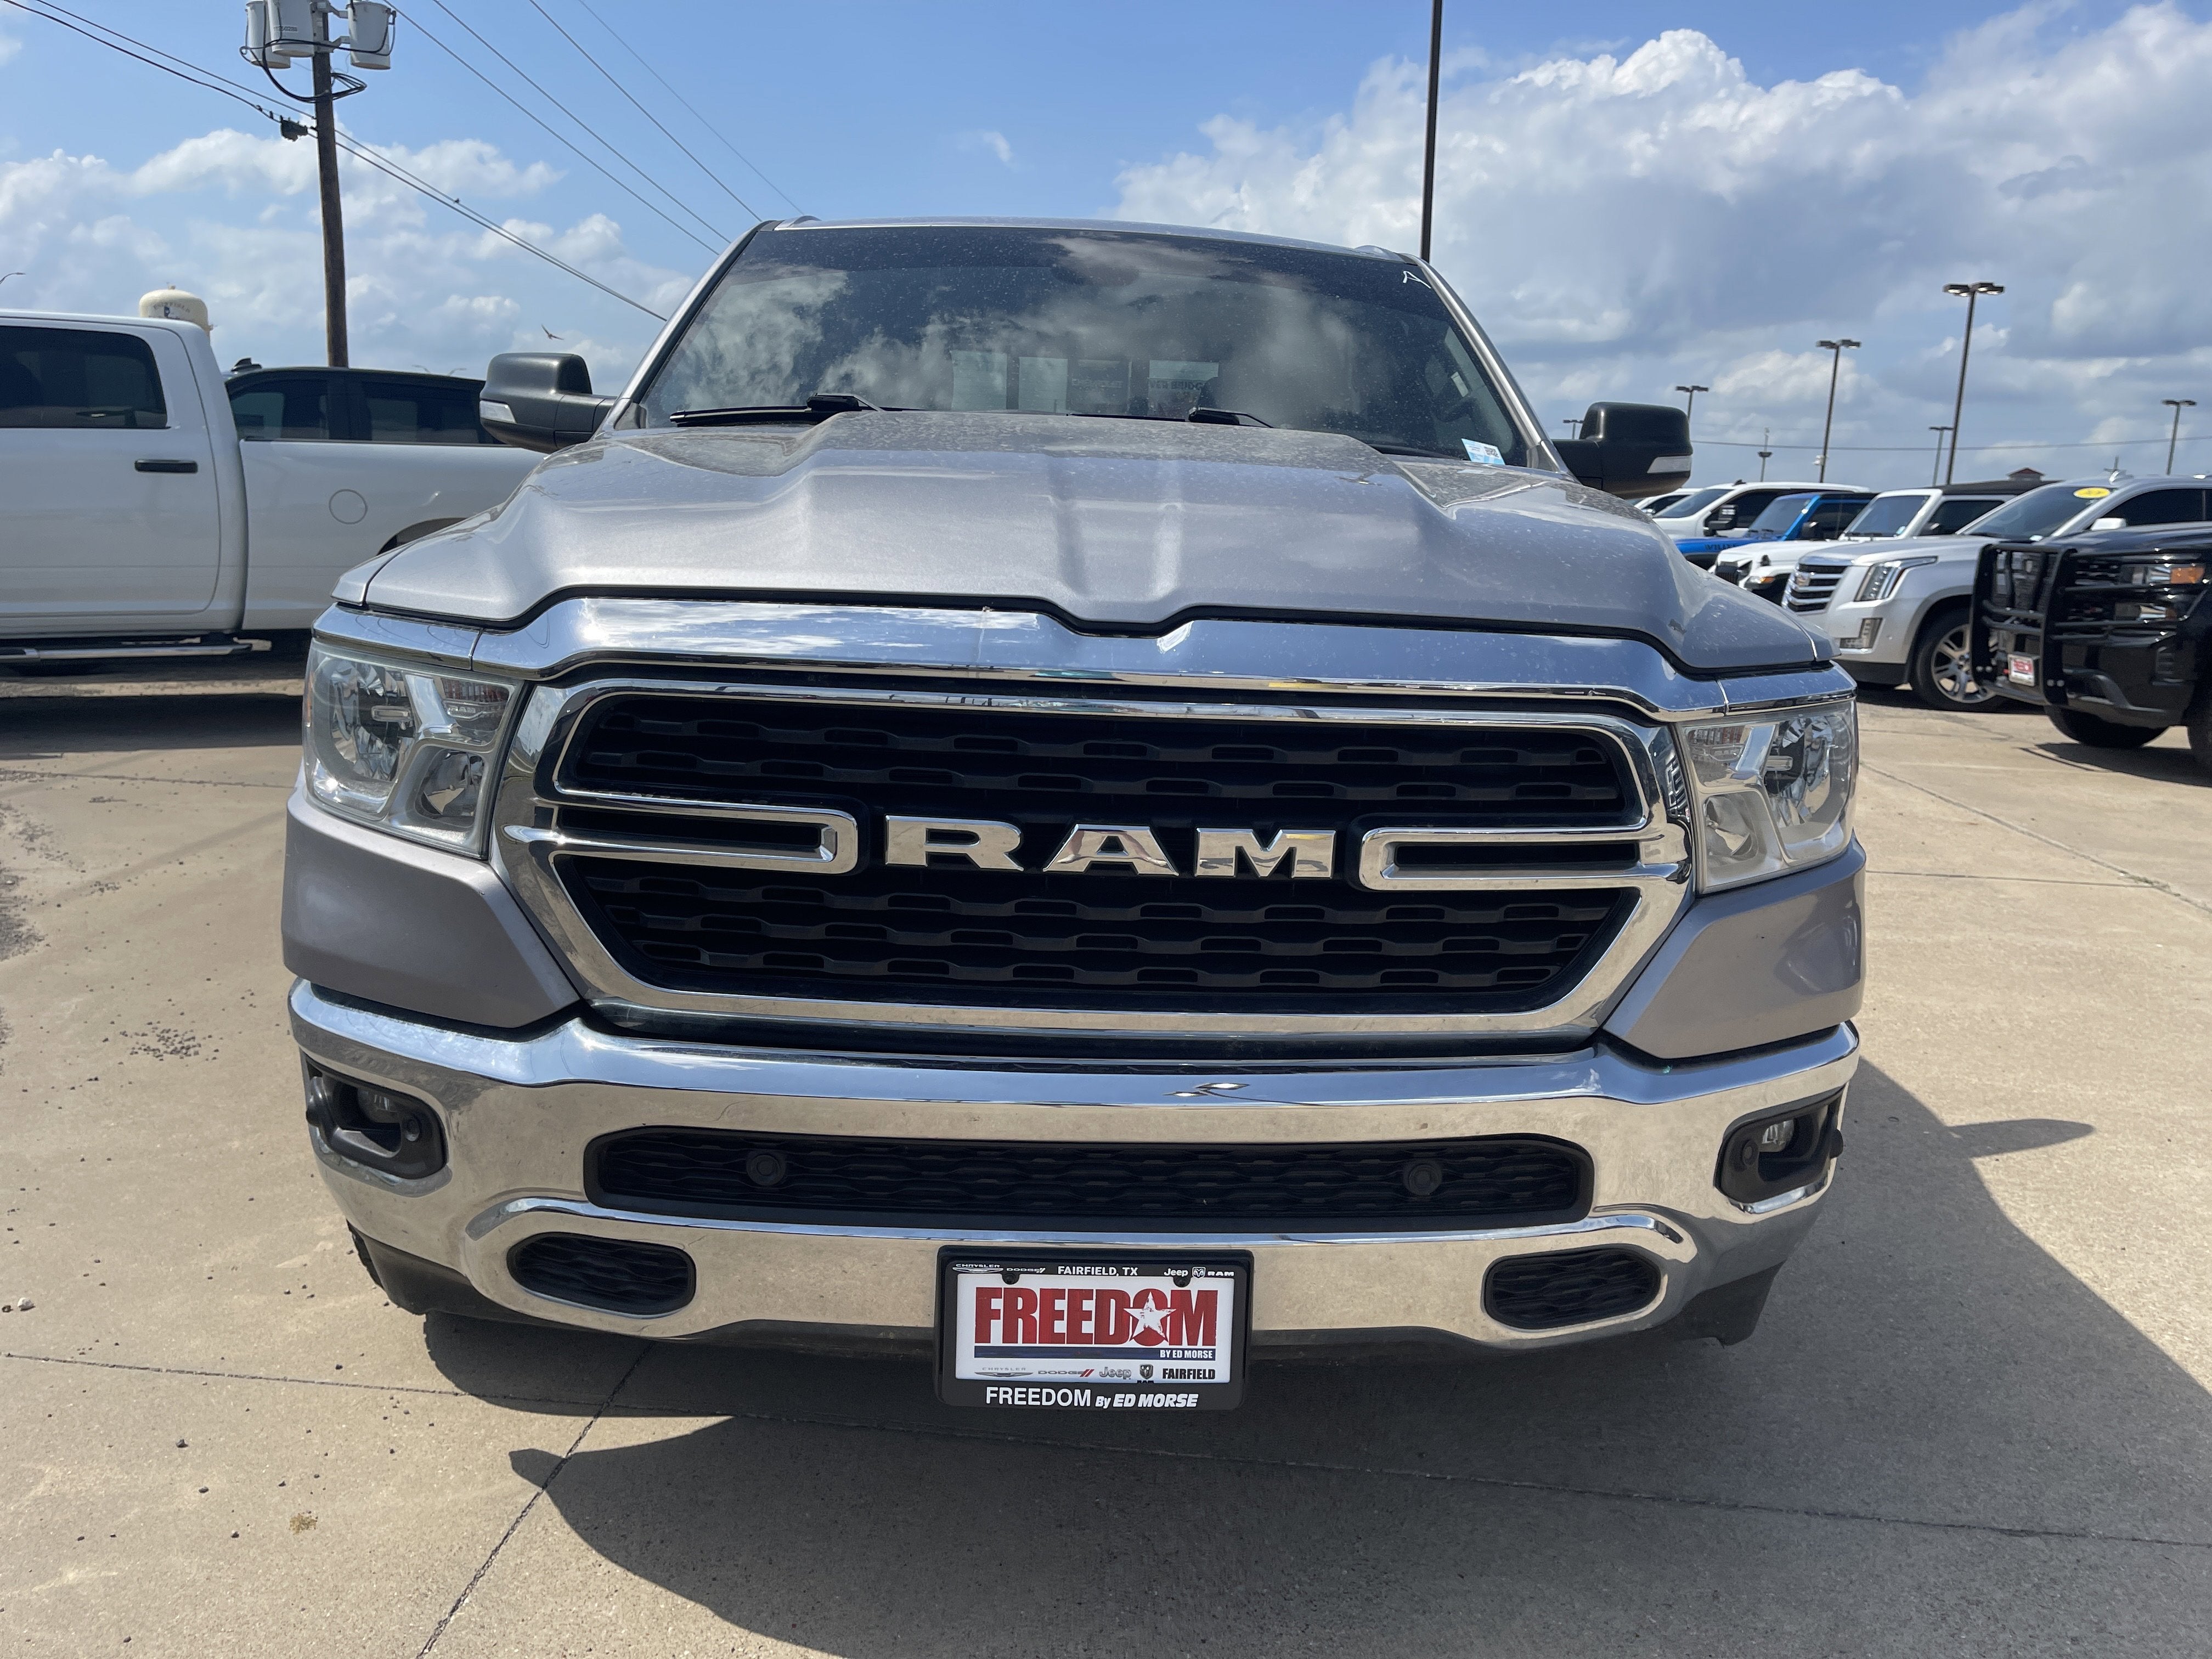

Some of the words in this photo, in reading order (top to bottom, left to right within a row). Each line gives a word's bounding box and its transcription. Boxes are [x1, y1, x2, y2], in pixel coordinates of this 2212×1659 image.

[885, 815, 1336, 878] RAM
[1058, 1266, 1119, 1277] FAIRFIELD,
[1122, 1267, 1138, 1276] TX
[1164, 1268, 1188, 1277] Jeep
[974, 1287, 1218, 1346] FREEDOM
[1160, 1350, 1171, 1358] BY
[1172, 1350, 1182, 1358] ED
[1184, 1350, 1213, 1359] MORSE
[1099, 1367, 1132, 1380] Jeep
[1163, 1368, 1216, 1380] FAIRFIELD
[986, 1387, 1091, 1407] FREEDOM
[1095, 1396, 1111, 1409] By
[1113, 1393, 1136, 1408] ED
[1138, 1393, 1199, 1408] MORSE
